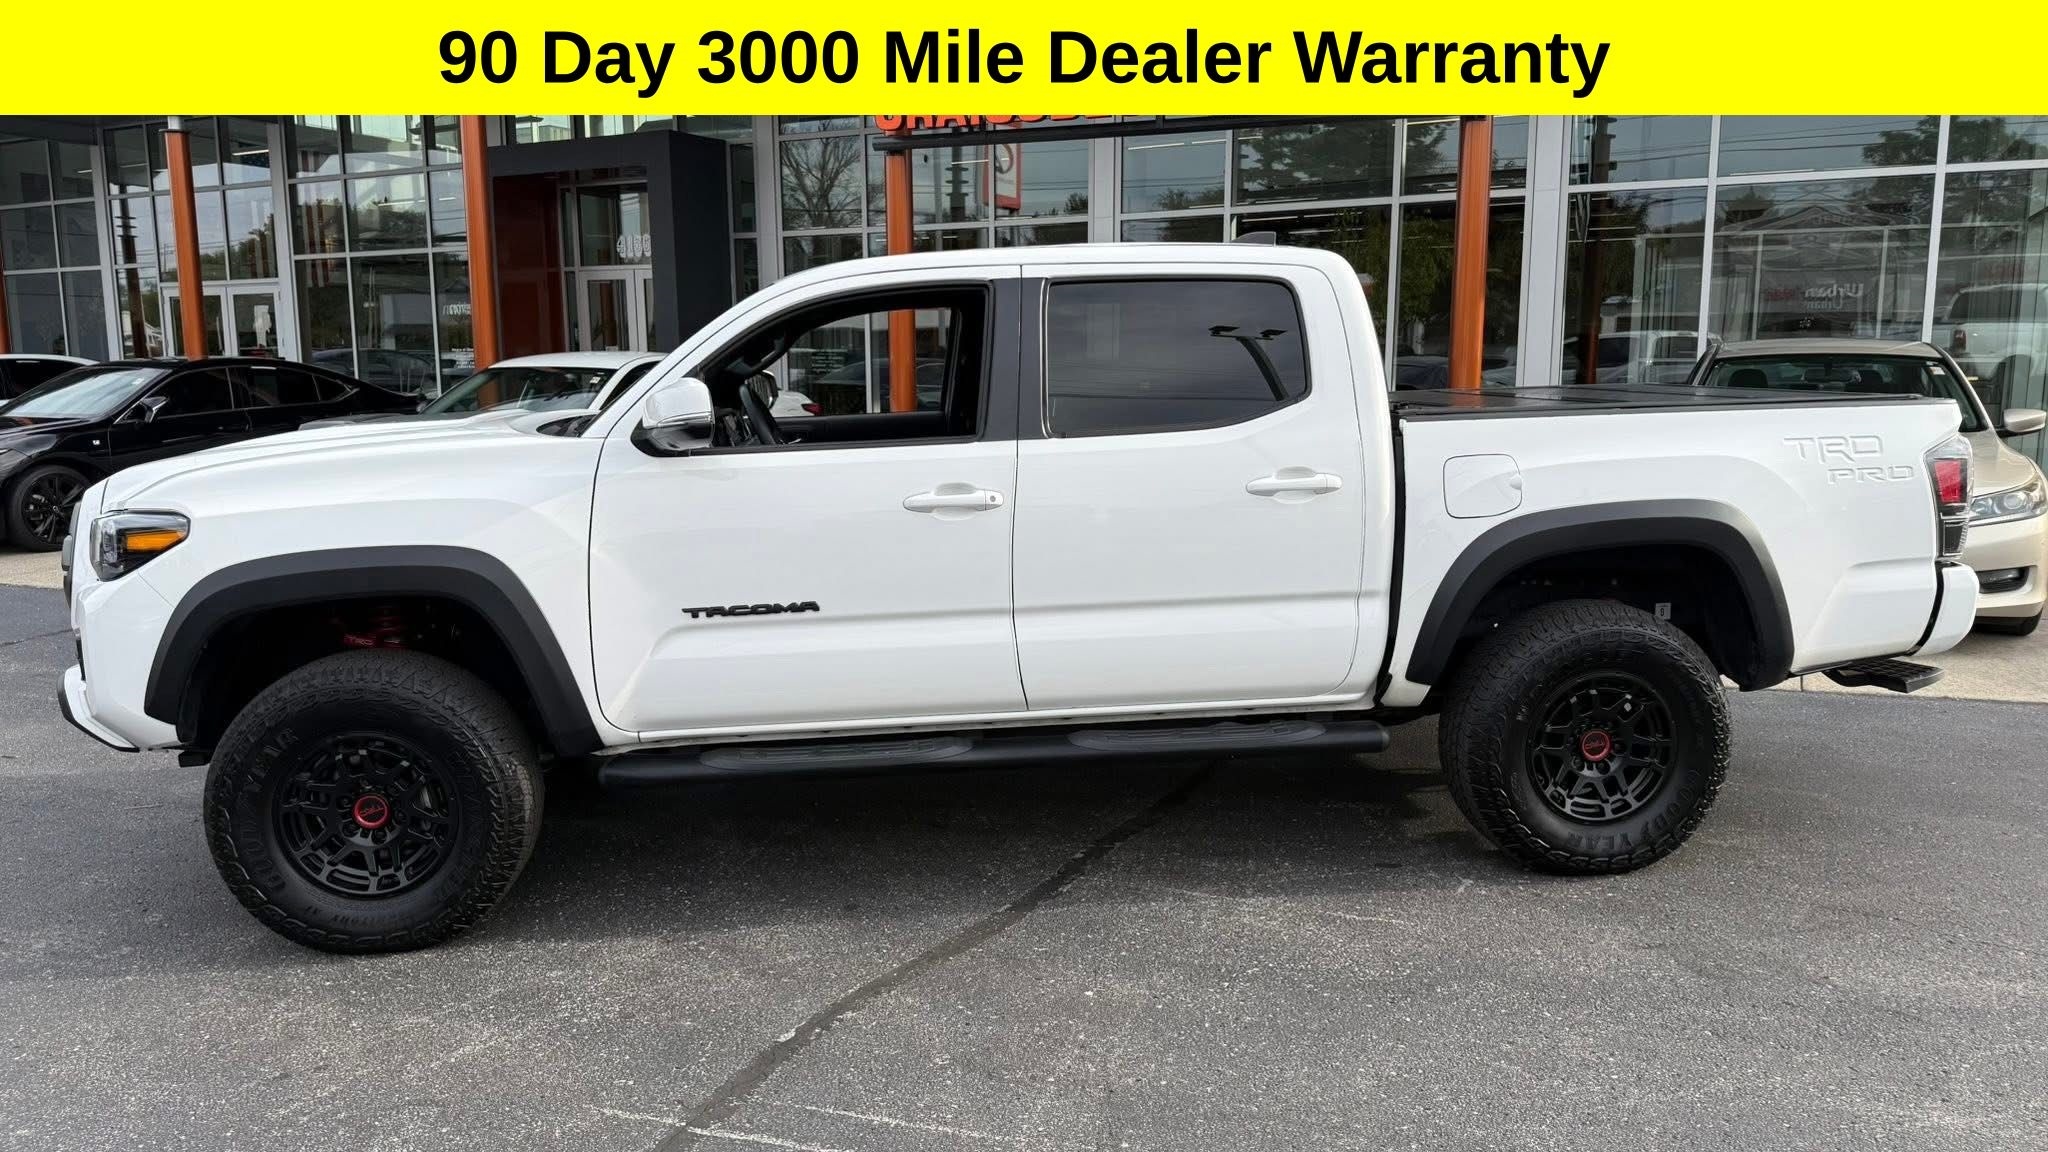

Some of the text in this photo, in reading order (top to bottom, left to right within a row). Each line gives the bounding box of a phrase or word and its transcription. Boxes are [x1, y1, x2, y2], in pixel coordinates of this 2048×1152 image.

[1783, 435, 1883, 464] TRD
[1827, 465, 1914, 484] PRO
[681, 601, 820, 618] TACOMA
